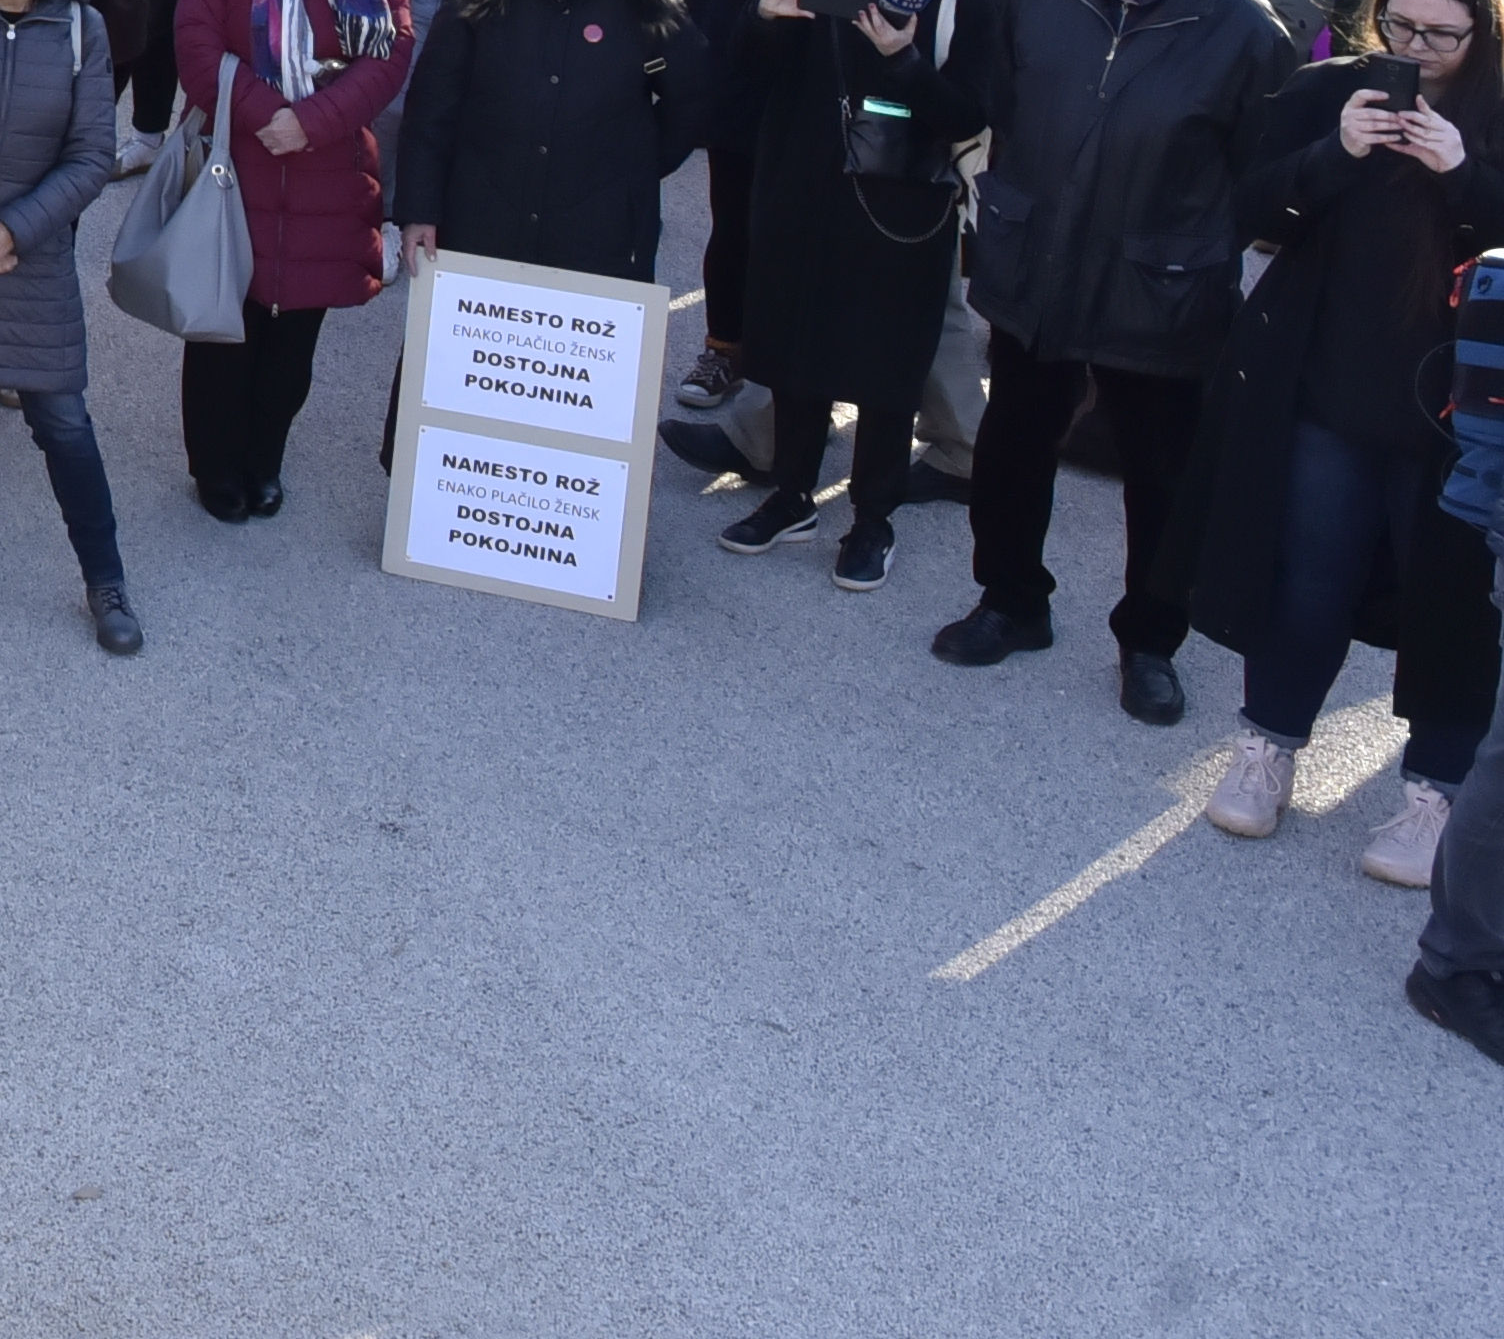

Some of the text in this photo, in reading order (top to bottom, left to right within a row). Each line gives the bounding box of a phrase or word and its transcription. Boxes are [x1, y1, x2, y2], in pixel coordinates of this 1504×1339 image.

[458, 298, 616, 339] NAMESTO ROŽ
[452, 323, 616, 363] ENAKO PLAČILO ŽENSK
[472, 349, 591, 383] DOSTOJNA
[464, 373, 593, 409] POKOJNINA
[442, 453, 601, 496] NAMESTO ROŽ
[437, 478, 600, 521] ENAKO PLAČILO ŽENSK
[457, 504, 575, 540] DOSTOJNA
[448, 529, 577, 567] POKOJNINA
